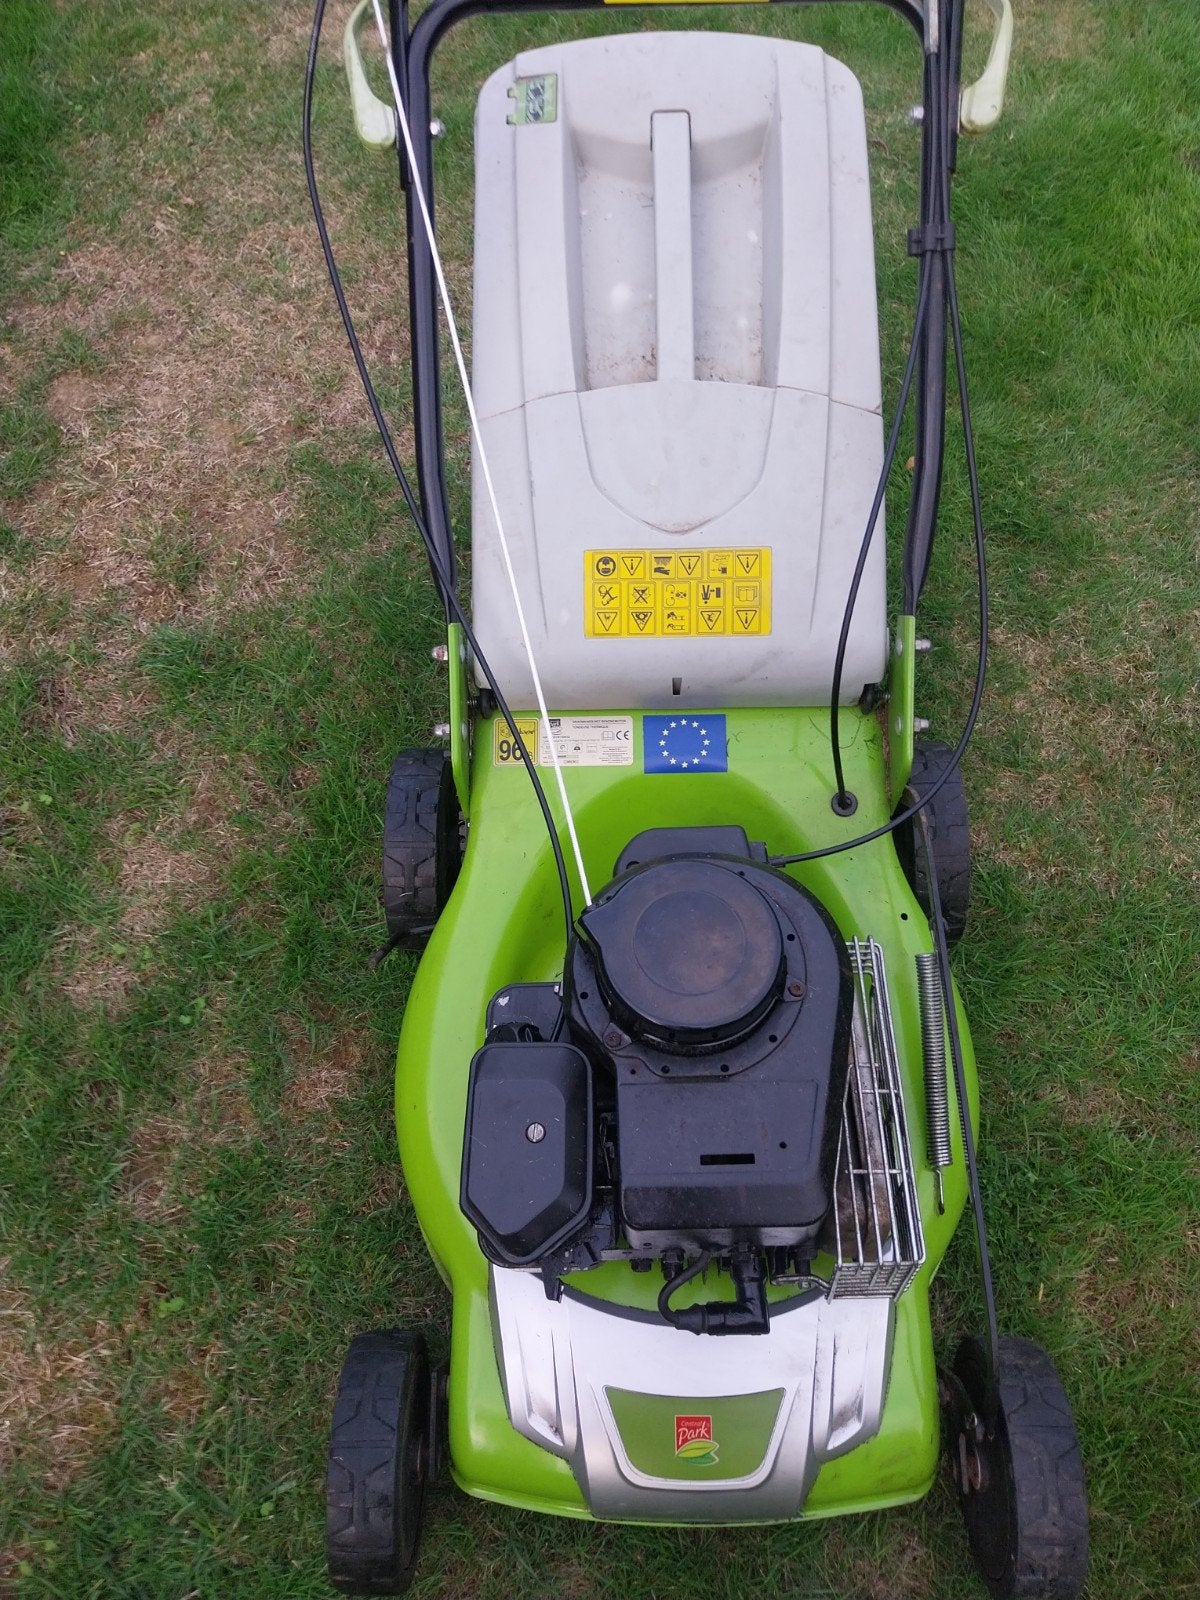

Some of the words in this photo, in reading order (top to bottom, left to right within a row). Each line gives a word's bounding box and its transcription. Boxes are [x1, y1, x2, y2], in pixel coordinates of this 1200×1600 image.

[616, 730, 630, 740] CE
[499, 739, 524, 761] 96
[678, 1421, 709, 1445] Park
